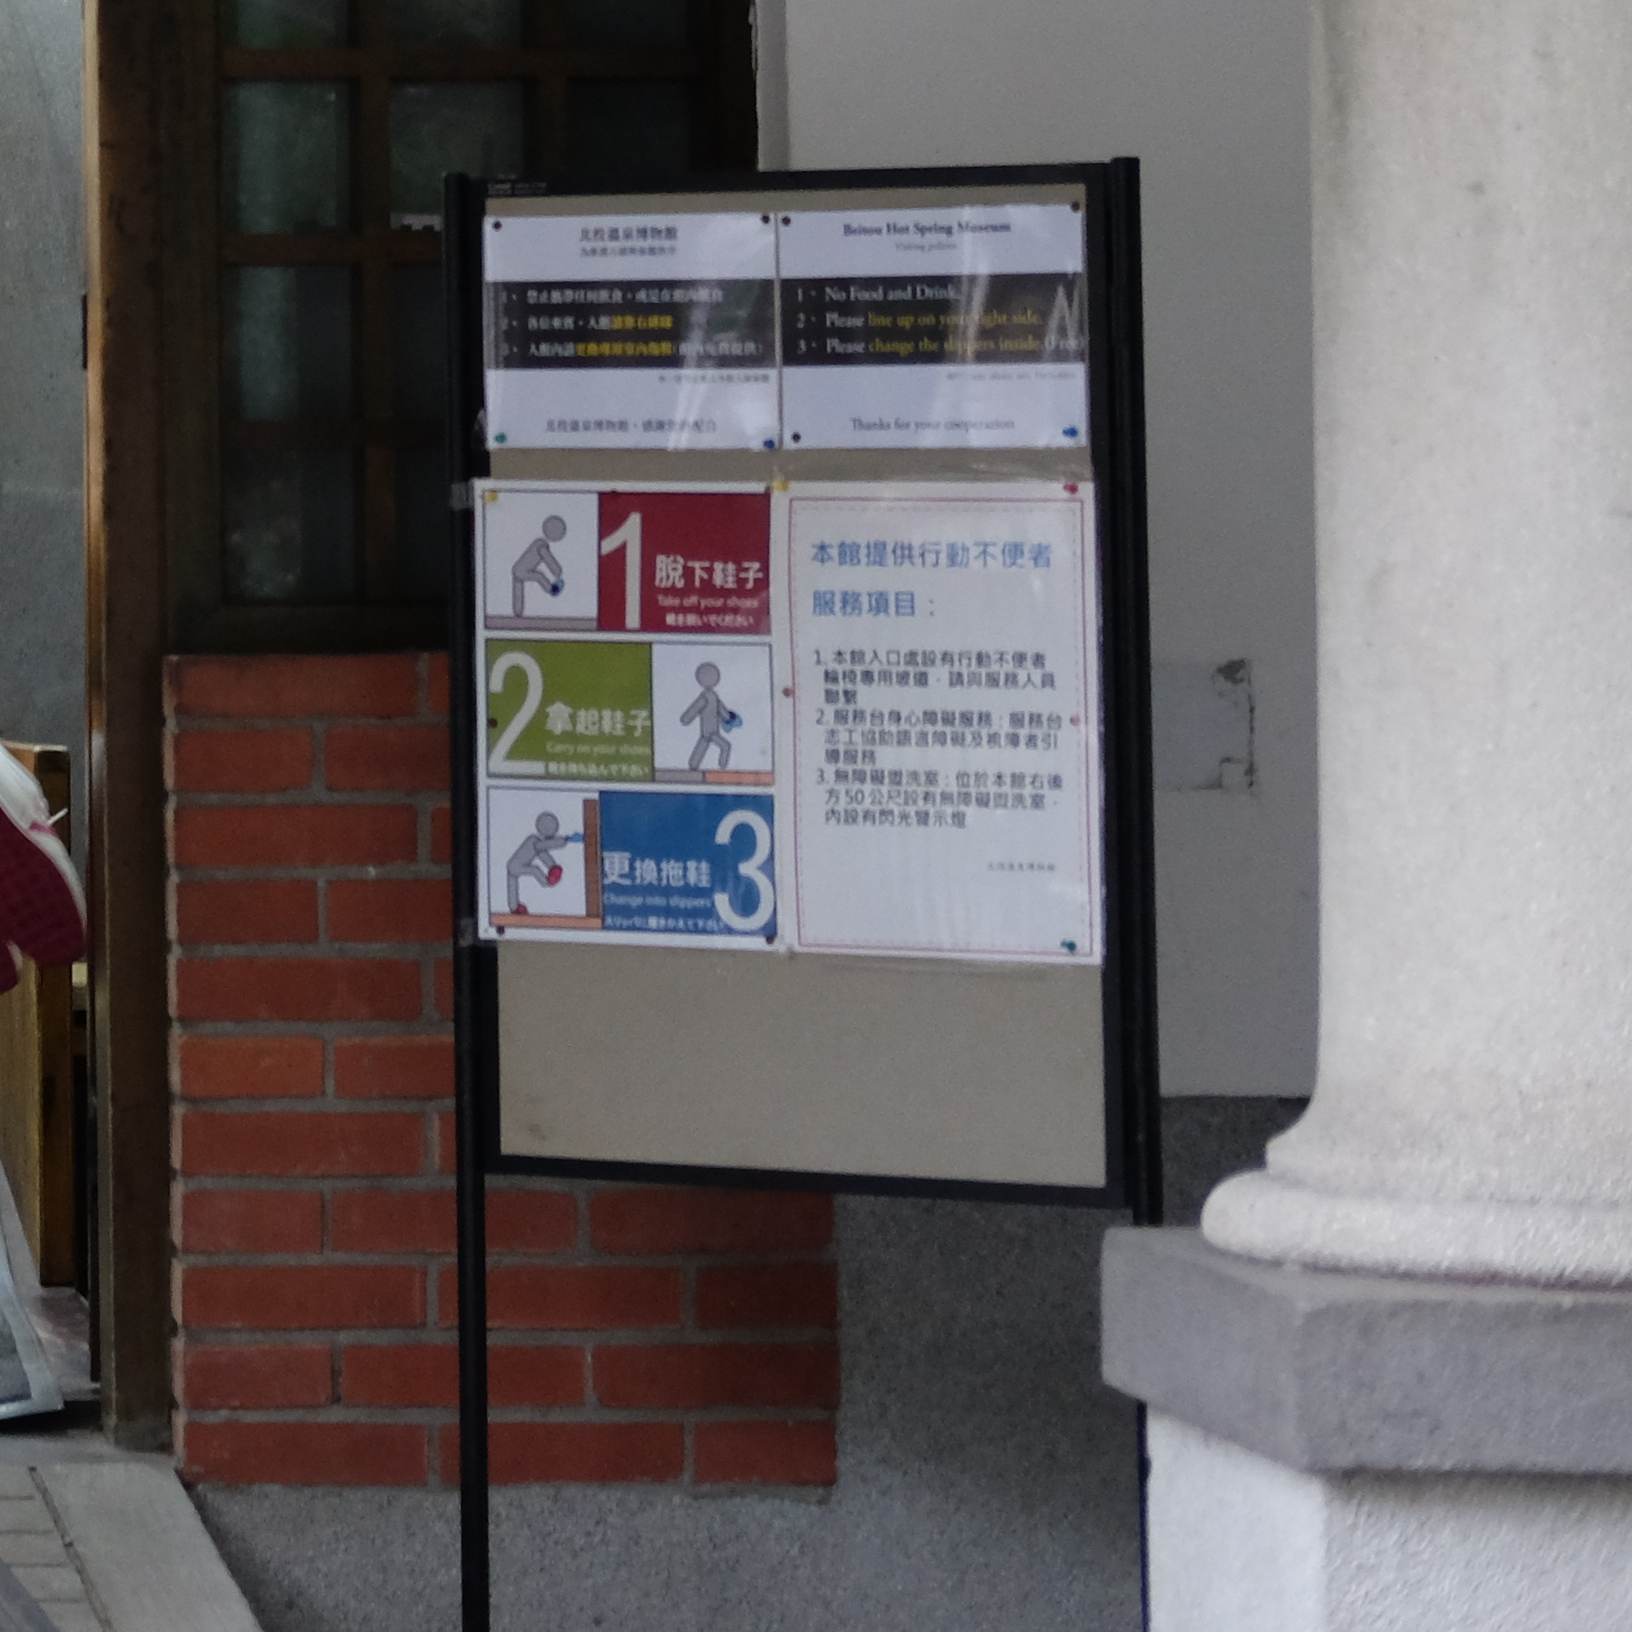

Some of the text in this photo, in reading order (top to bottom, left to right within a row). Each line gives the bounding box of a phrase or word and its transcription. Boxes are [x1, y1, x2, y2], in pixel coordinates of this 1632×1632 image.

[886, 222, 910, 235] Hot
[957, 221, 1012, 234] Museum
[825, 286, 846, 301] No
[850, 286, 883, 301] Food
[887, 285, 912, 301] and
[825, 313, 864, 328] Please
[897, 314, 913, 332] up
[918, 315, 936, 328] on
[825, 338, 865, 353] Please
[868, 336, 916, 357] change
[919, 336, 938, 352] the
[850, 416, 891, 431] Thanks
[894, 416, 911, 431] for
[914, 419, 940, 434] your
[811, 539, 1053, 569] 本館提供行動不便者
[600, 511, 643, 630] 1
[654, 554, 764, 590] 脫下鞋子
[700, 597, 725, 610] your
[727, 596, 759, 609] shoes
[489, 651, 546, 775] 2
[545, 701, 651, 738] 拿起鞋子
[593, 744, 617, 756] your
[603, 851, 712, 888] 更換拖鞋
[714, 809, 774, 931] 3
